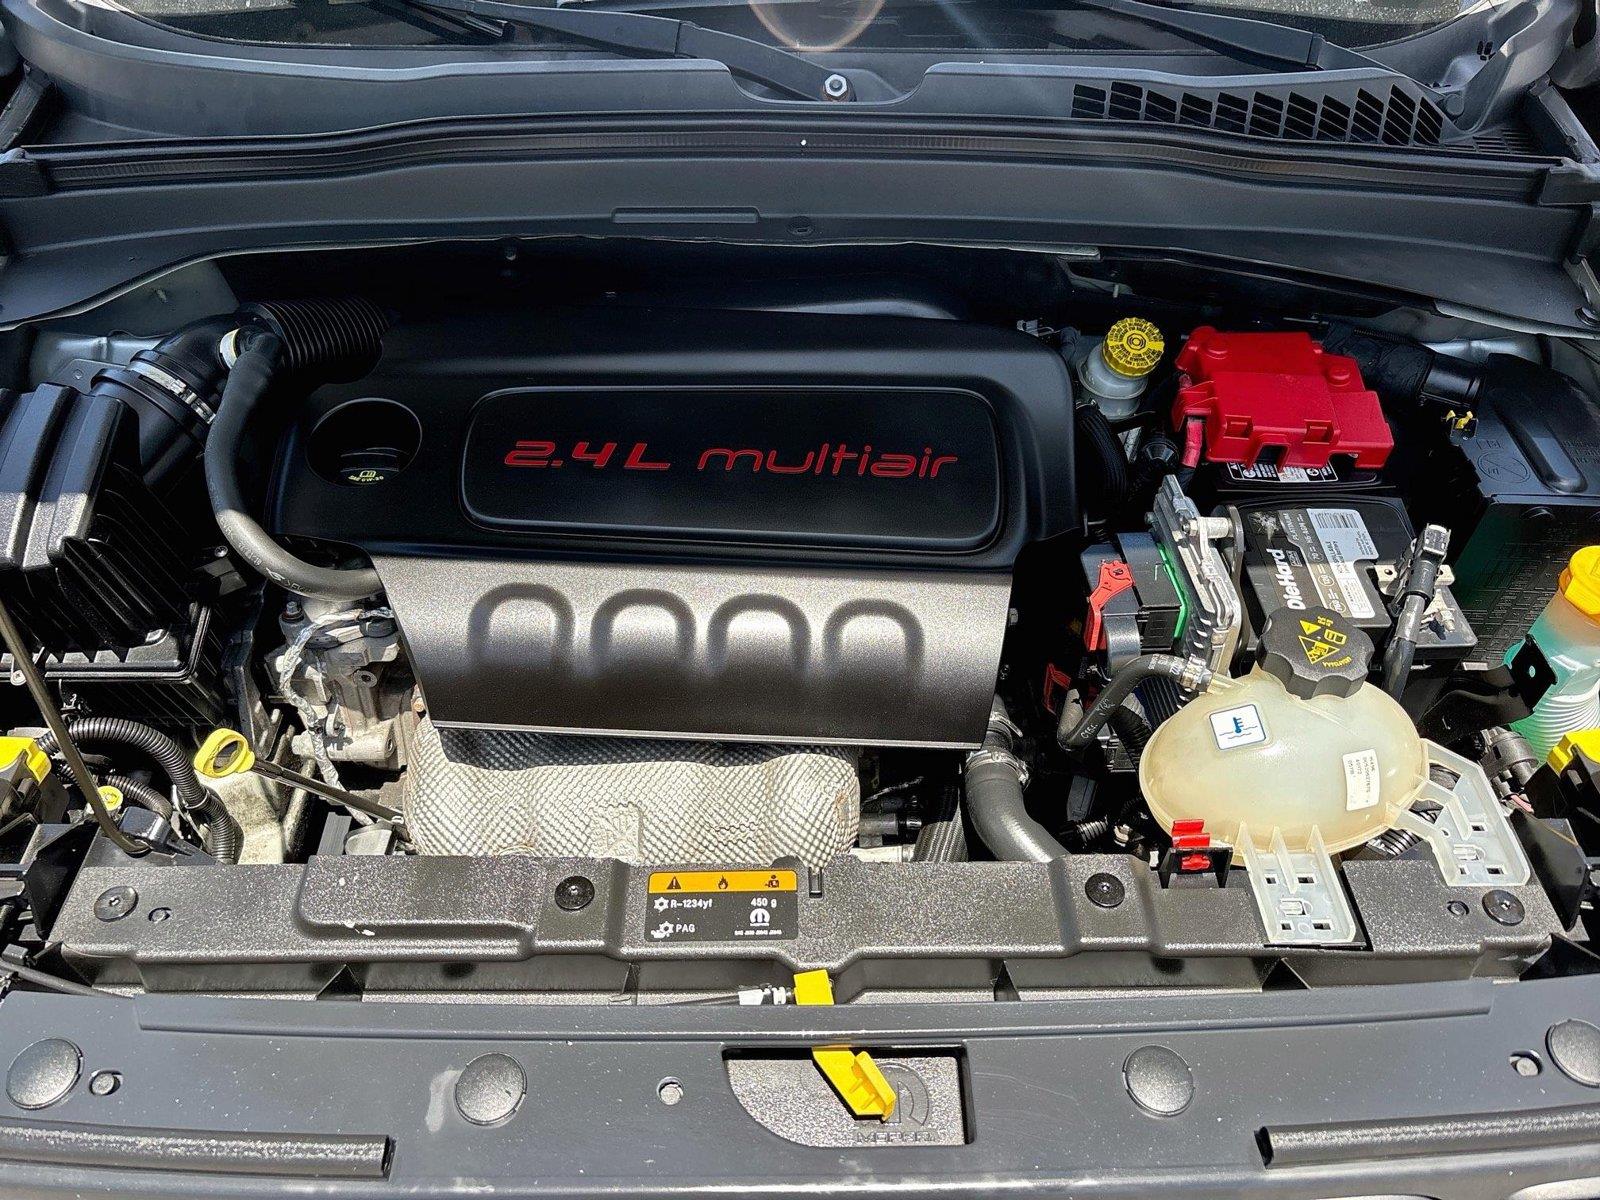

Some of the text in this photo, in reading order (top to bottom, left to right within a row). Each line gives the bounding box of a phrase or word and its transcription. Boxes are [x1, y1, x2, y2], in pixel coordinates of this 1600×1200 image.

[697, 444, 958, 478] multiair
[1266, 548, 1307, 610] DieHard
[670, 898, 713, 909] R-1234yf
[751, 897, 768, 908] 450
[675, 923, 696, 934] PAG
